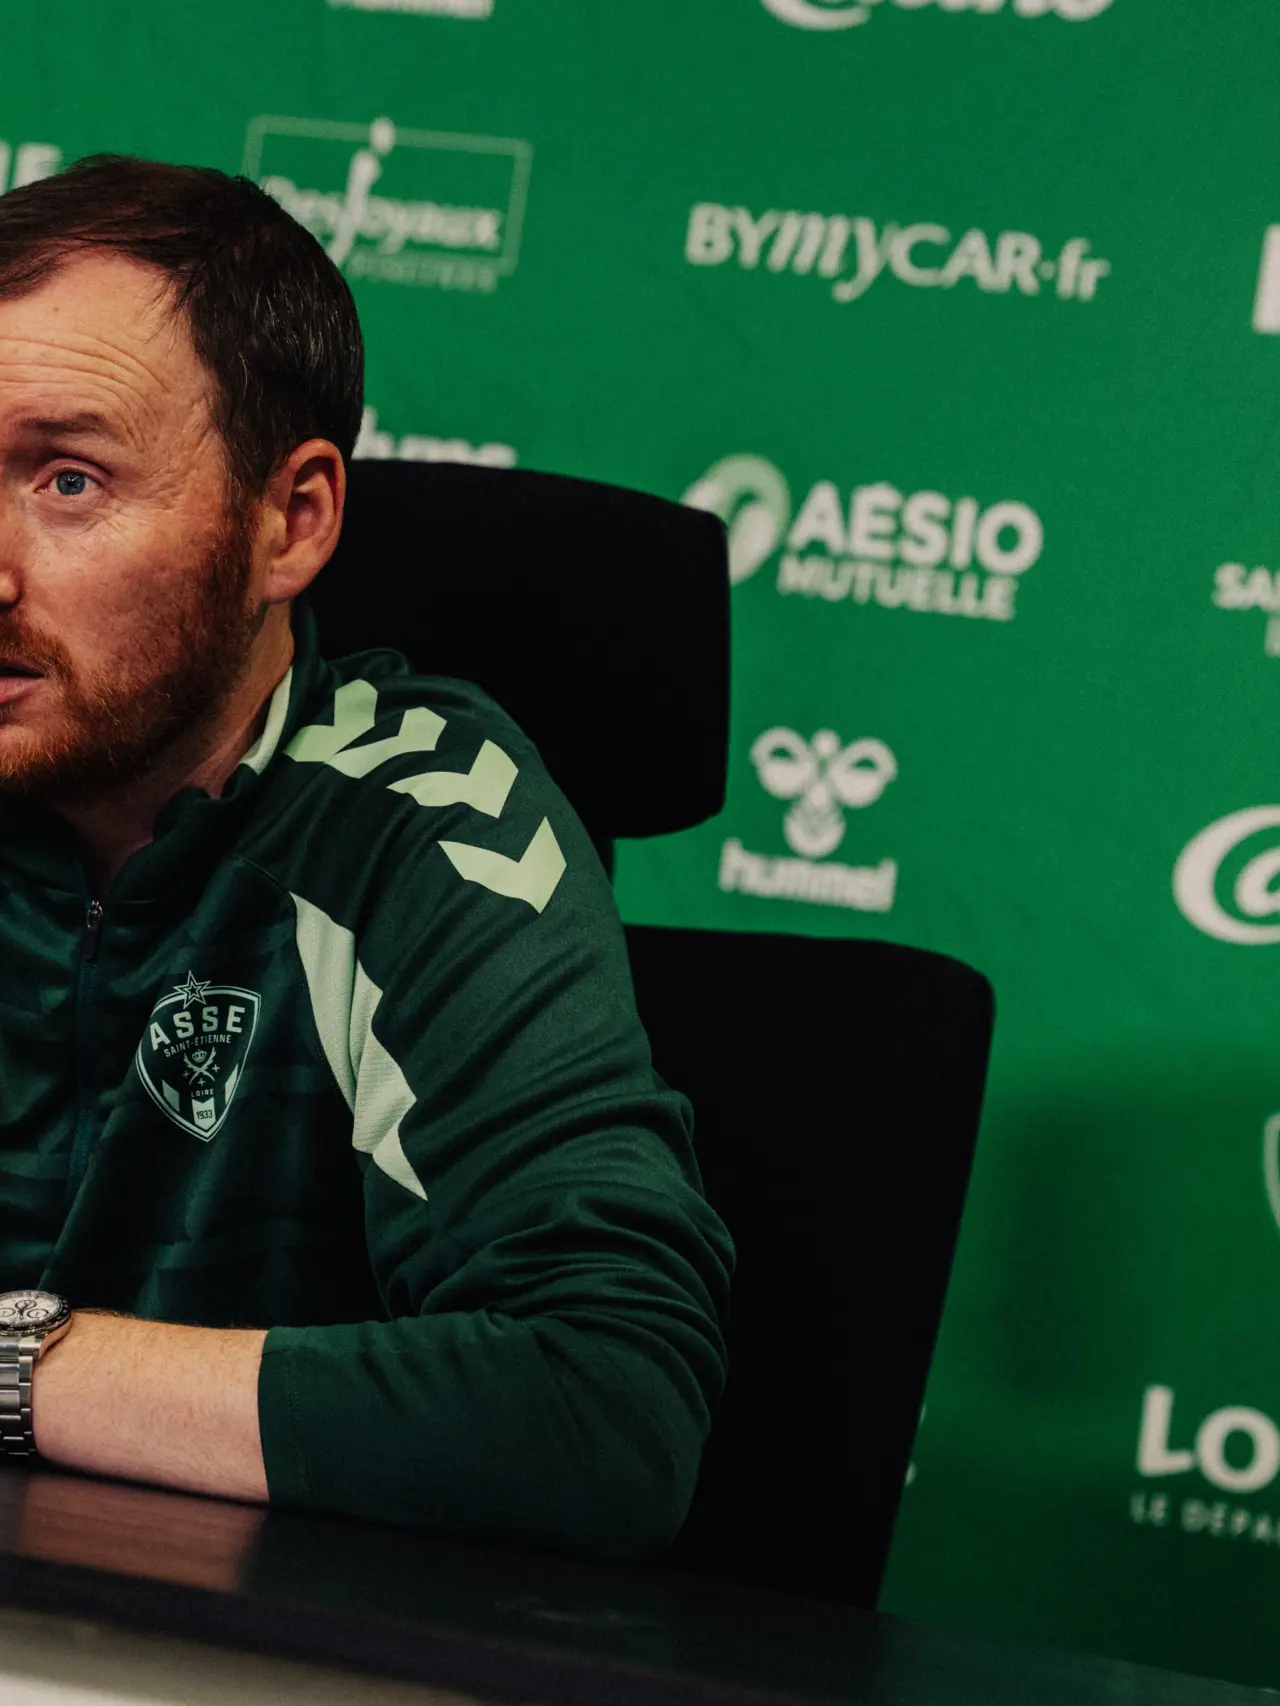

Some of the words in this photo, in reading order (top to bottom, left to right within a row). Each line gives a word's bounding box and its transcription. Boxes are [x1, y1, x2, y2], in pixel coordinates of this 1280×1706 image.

[777, 552, 1018, 621] MUTUELLE
[718, 838, 898, 912] hummel
[149, 1005, 246, 1051] ASSE
[163, 1034, 232, 1058] SAINT-ÉTIENNE
[195, 1109, 214, 1120] 1933
